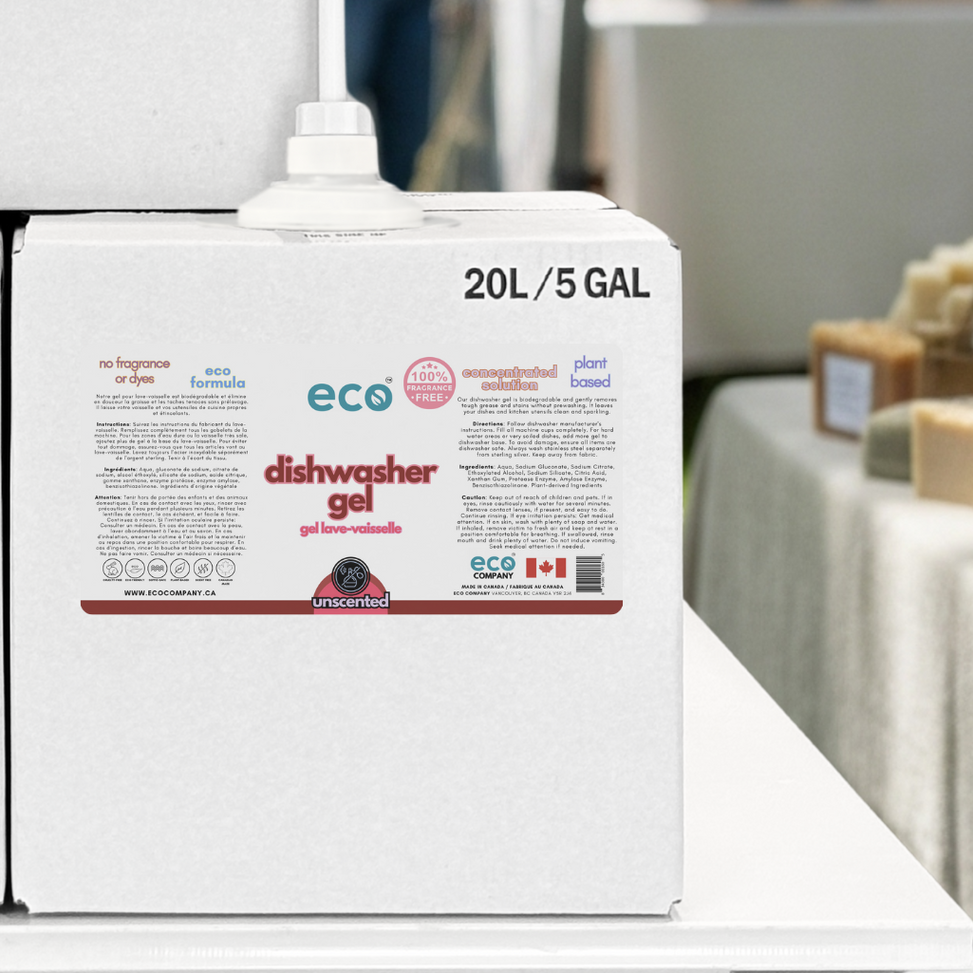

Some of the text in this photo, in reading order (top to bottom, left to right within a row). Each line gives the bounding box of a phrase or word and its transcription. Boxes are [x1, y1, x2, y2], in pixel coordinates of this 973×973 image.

[584, 267, 651, 299] GAL
[99, 356, 171, 372] no fragrance
[205, 367, 231, 376] eco
[461, 364, 558, 379] concentrated
[574, 355, 608, 373] plant
[115, 371, 155, 388] or dyes
[190, 375, 246, 389] formula
[411, 372, 448, 382] 100%
[479, 377, 539, 391] solution
[570, 374, 611, 388] based
[307, 383, 393, 412] eco
[264, 454, 440, 485] dishwasher
[327, 484, 374, 520] gel
[299, 521, 403, 538] gel lave-vaisselle
[470, 556, 516, 571] eco
[473, 571, 514, 580] COMPANY
[311, 592, 390, 609] unscented
